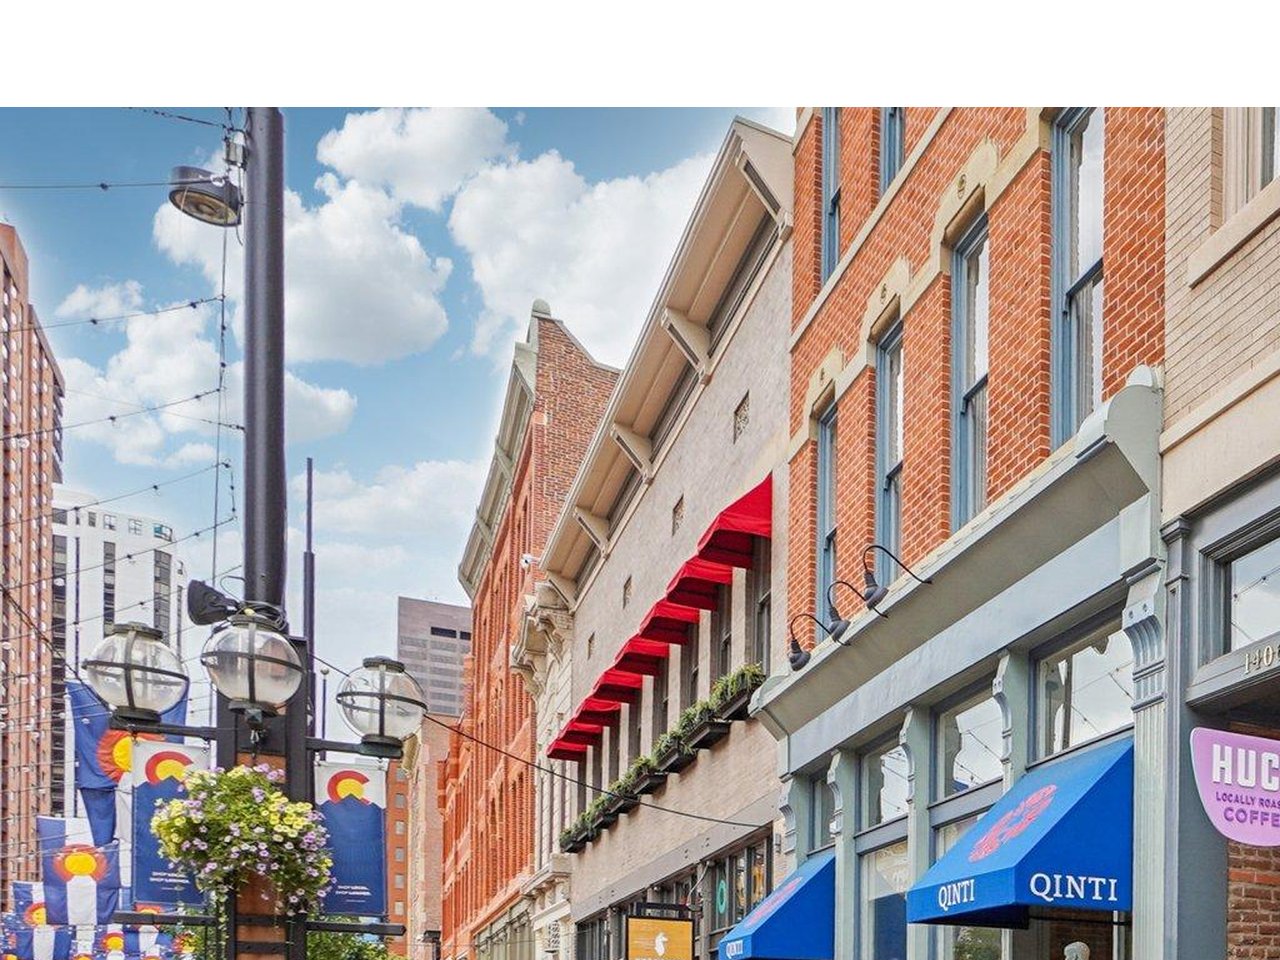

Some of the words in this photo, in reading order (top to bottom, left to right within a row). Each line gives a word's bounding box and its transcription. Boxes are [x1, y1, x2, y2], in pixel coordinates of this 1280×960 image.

[1216, 791, 1256, 807] LOCALLY
[938, 879, 975, 911] QINTI
[1029, 873, 1118, 903] QINTI
